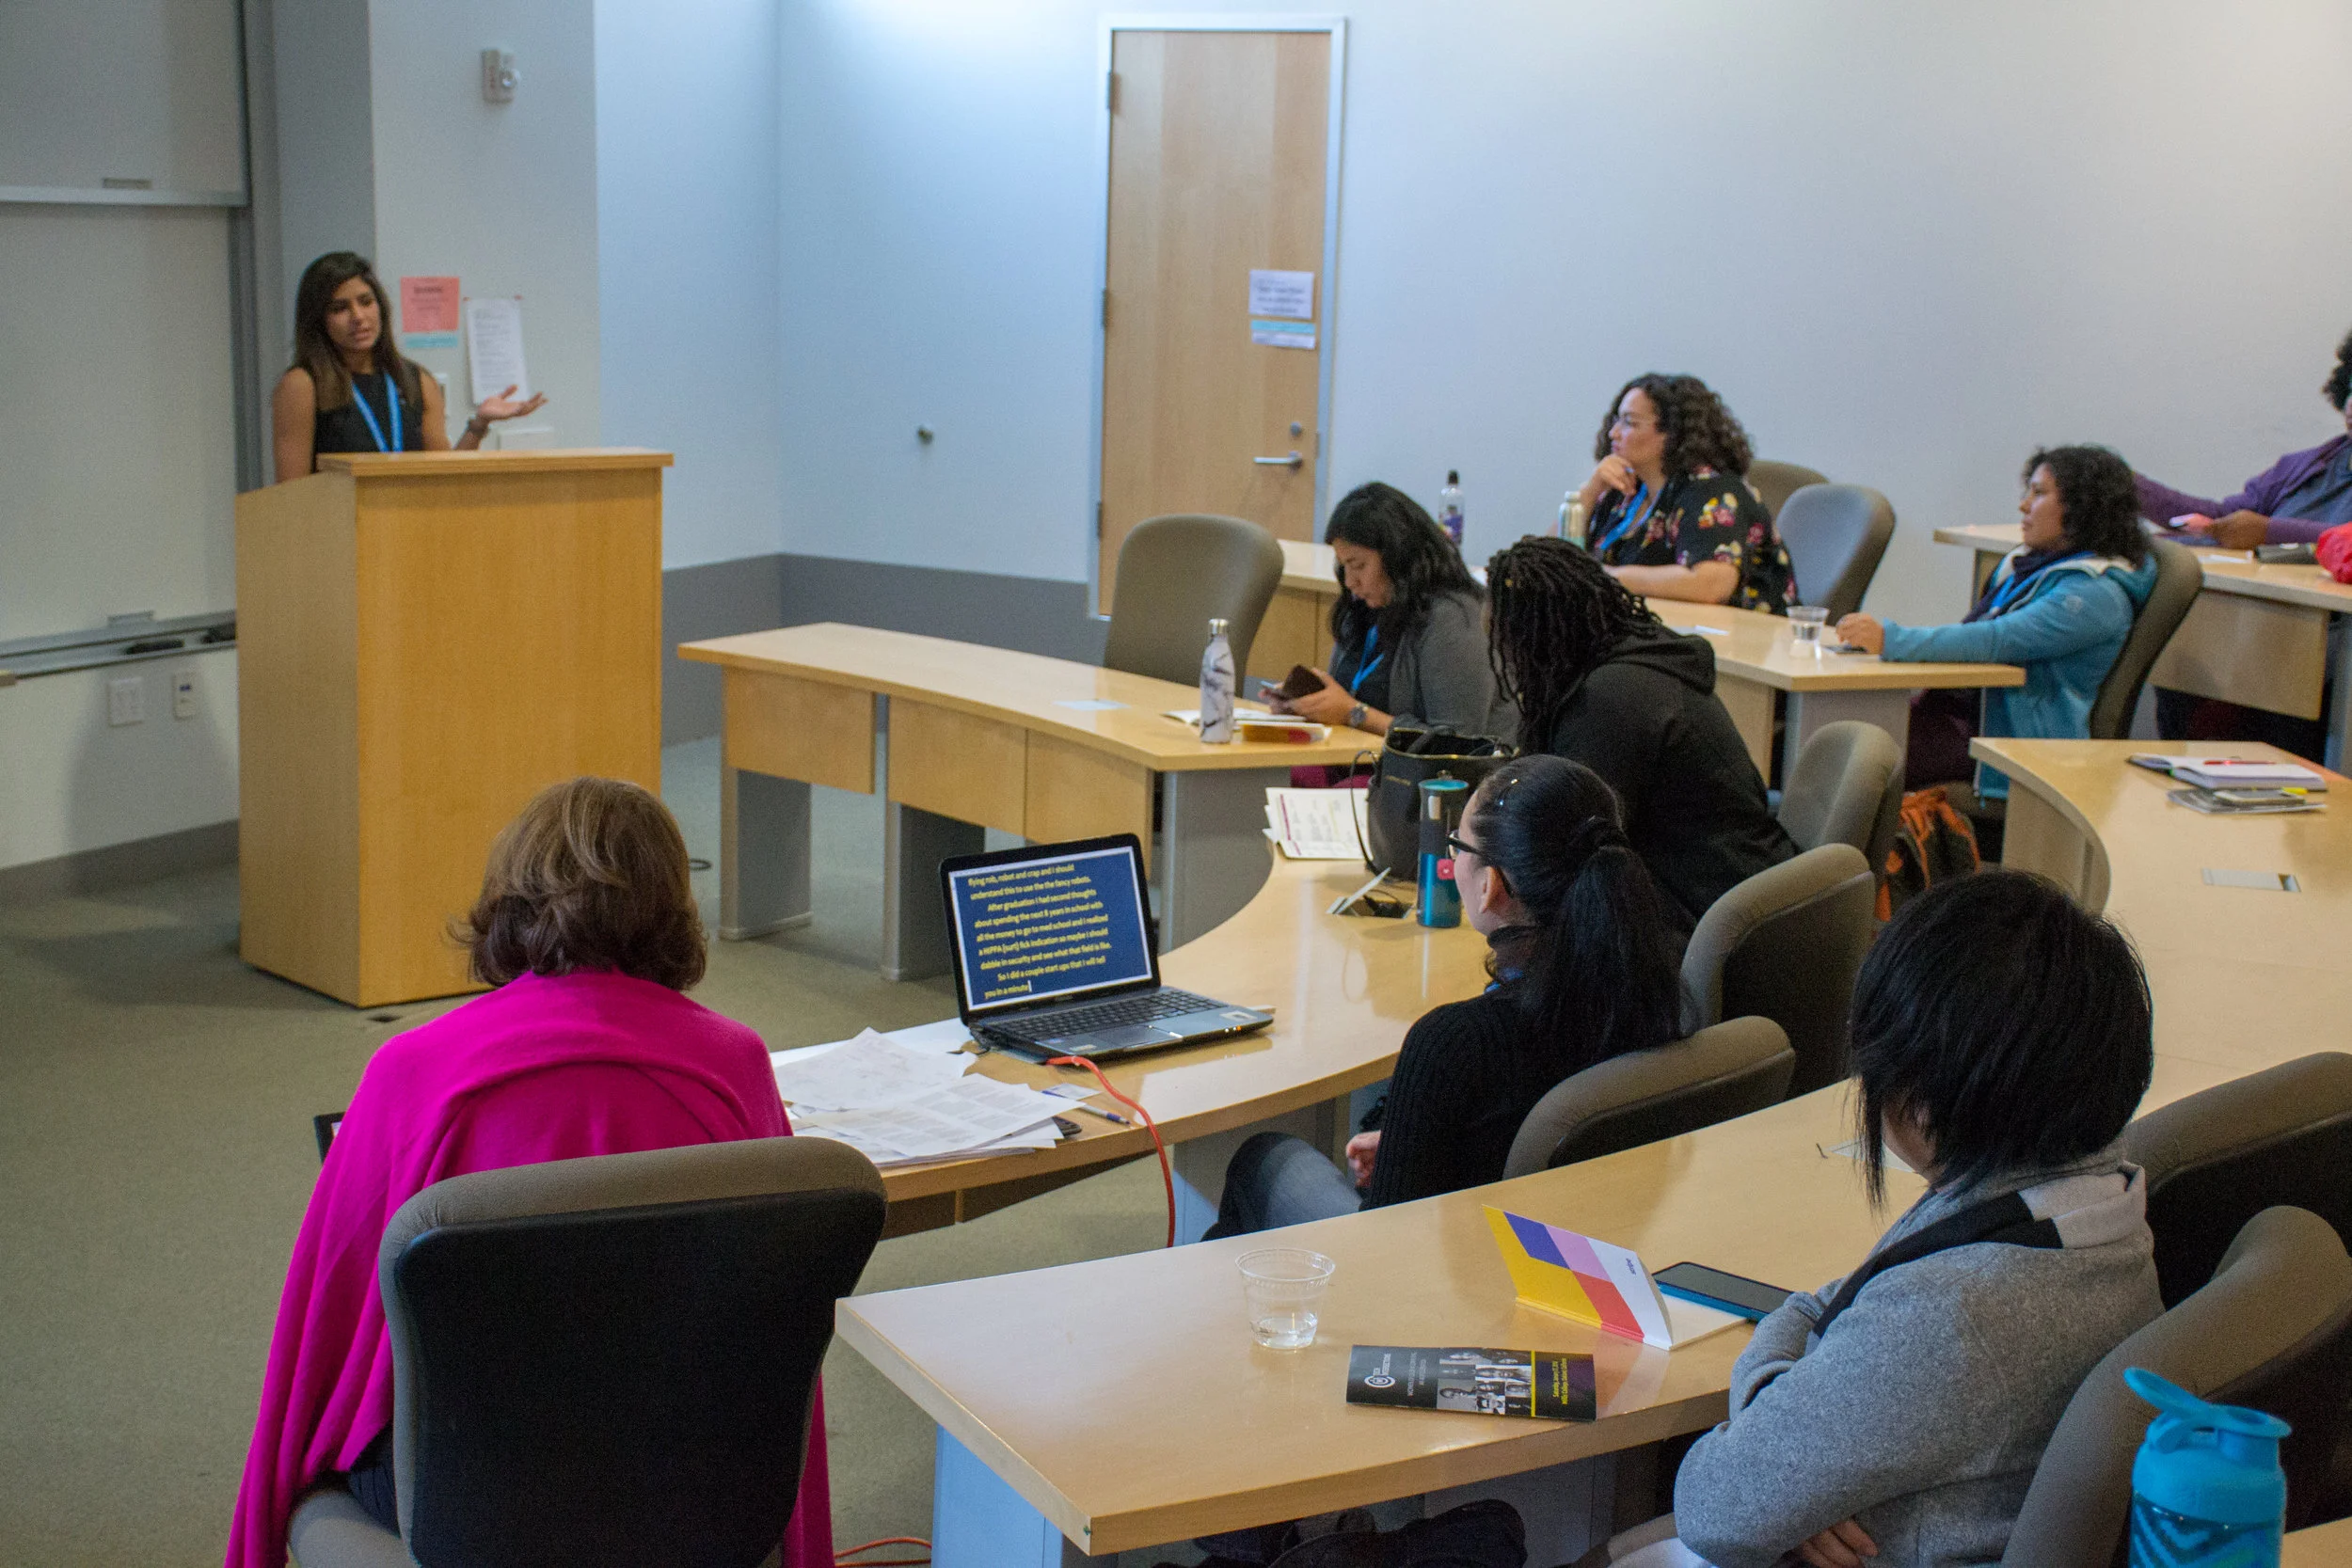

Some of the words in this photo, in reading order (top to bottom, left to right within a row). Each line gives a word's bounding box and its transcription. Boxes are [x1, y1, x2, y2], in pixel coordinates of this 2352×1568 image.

[997, 874, 1015, 882] robot
[1014, 871, 1026, 879] and
[1041, 867, 1051, 876] and
[1055, 864, 1074, 873] should
[971, 888, 1004, 900] understand
[988, 903, 1003, 911] After
[1003, 899, 1035, 911] graduation
[1038, 895, 1050, 904] had
[1049, 892, 1071, 902] second
[1070, 889, 1097, 899] thoughts
[975, 919, 993, 928] about
[993, 915, 1020, 926] spending
[1049, 908, 1064, 917] years
[1070, 904, 1089, 913] school
[1089, 901, 1103, 910] with
[994, 930, 1015, 939] money
[1023, 927, 1031, 936] go
[1039, 924, 1053, 932] med
[1052, 921, 1072, 930] school
[1071, 918, 1083, 927] and
[1089, 928, 1108, 938] should
[980, 960, 1001, 970] dabble
[1007, 955, 1030, 965] security
[1030, 953, 1042, 961] and
[1068, 946, 1081, 955] that
[1009, 971, 1020, 979] did
[1024, 967, 1044, 976] couple
[1044, 964, 1058, 973] start
[1069, 960, 1081, 969] that
[1085, 958, 1095, 966] will
[984, 990, 996, 999] you
